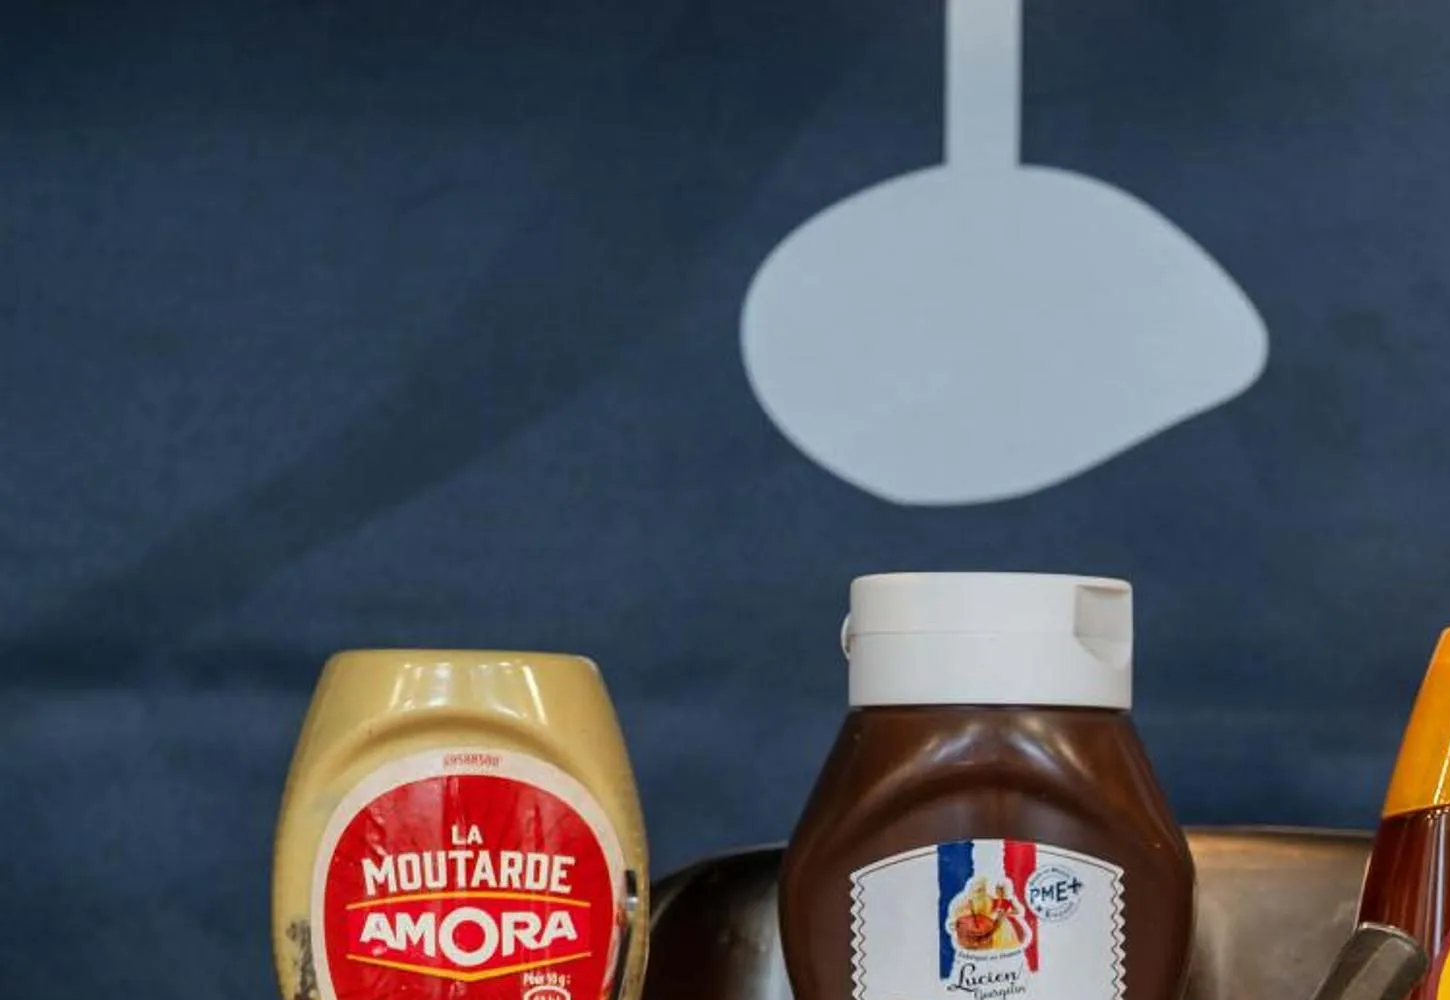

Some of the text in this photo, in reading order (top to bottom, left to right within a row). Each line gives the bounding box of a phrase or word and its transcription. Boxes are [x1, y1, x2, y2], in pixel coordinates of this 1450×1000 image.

[451, 824, 484, 845] LA
[361, 850, 576, 896] MOUTARDE
[1029, 876, 1083, 903] PME+
[359, 906, 578, 967] AMORA
[947, 963, 1022, 992] Lucien
